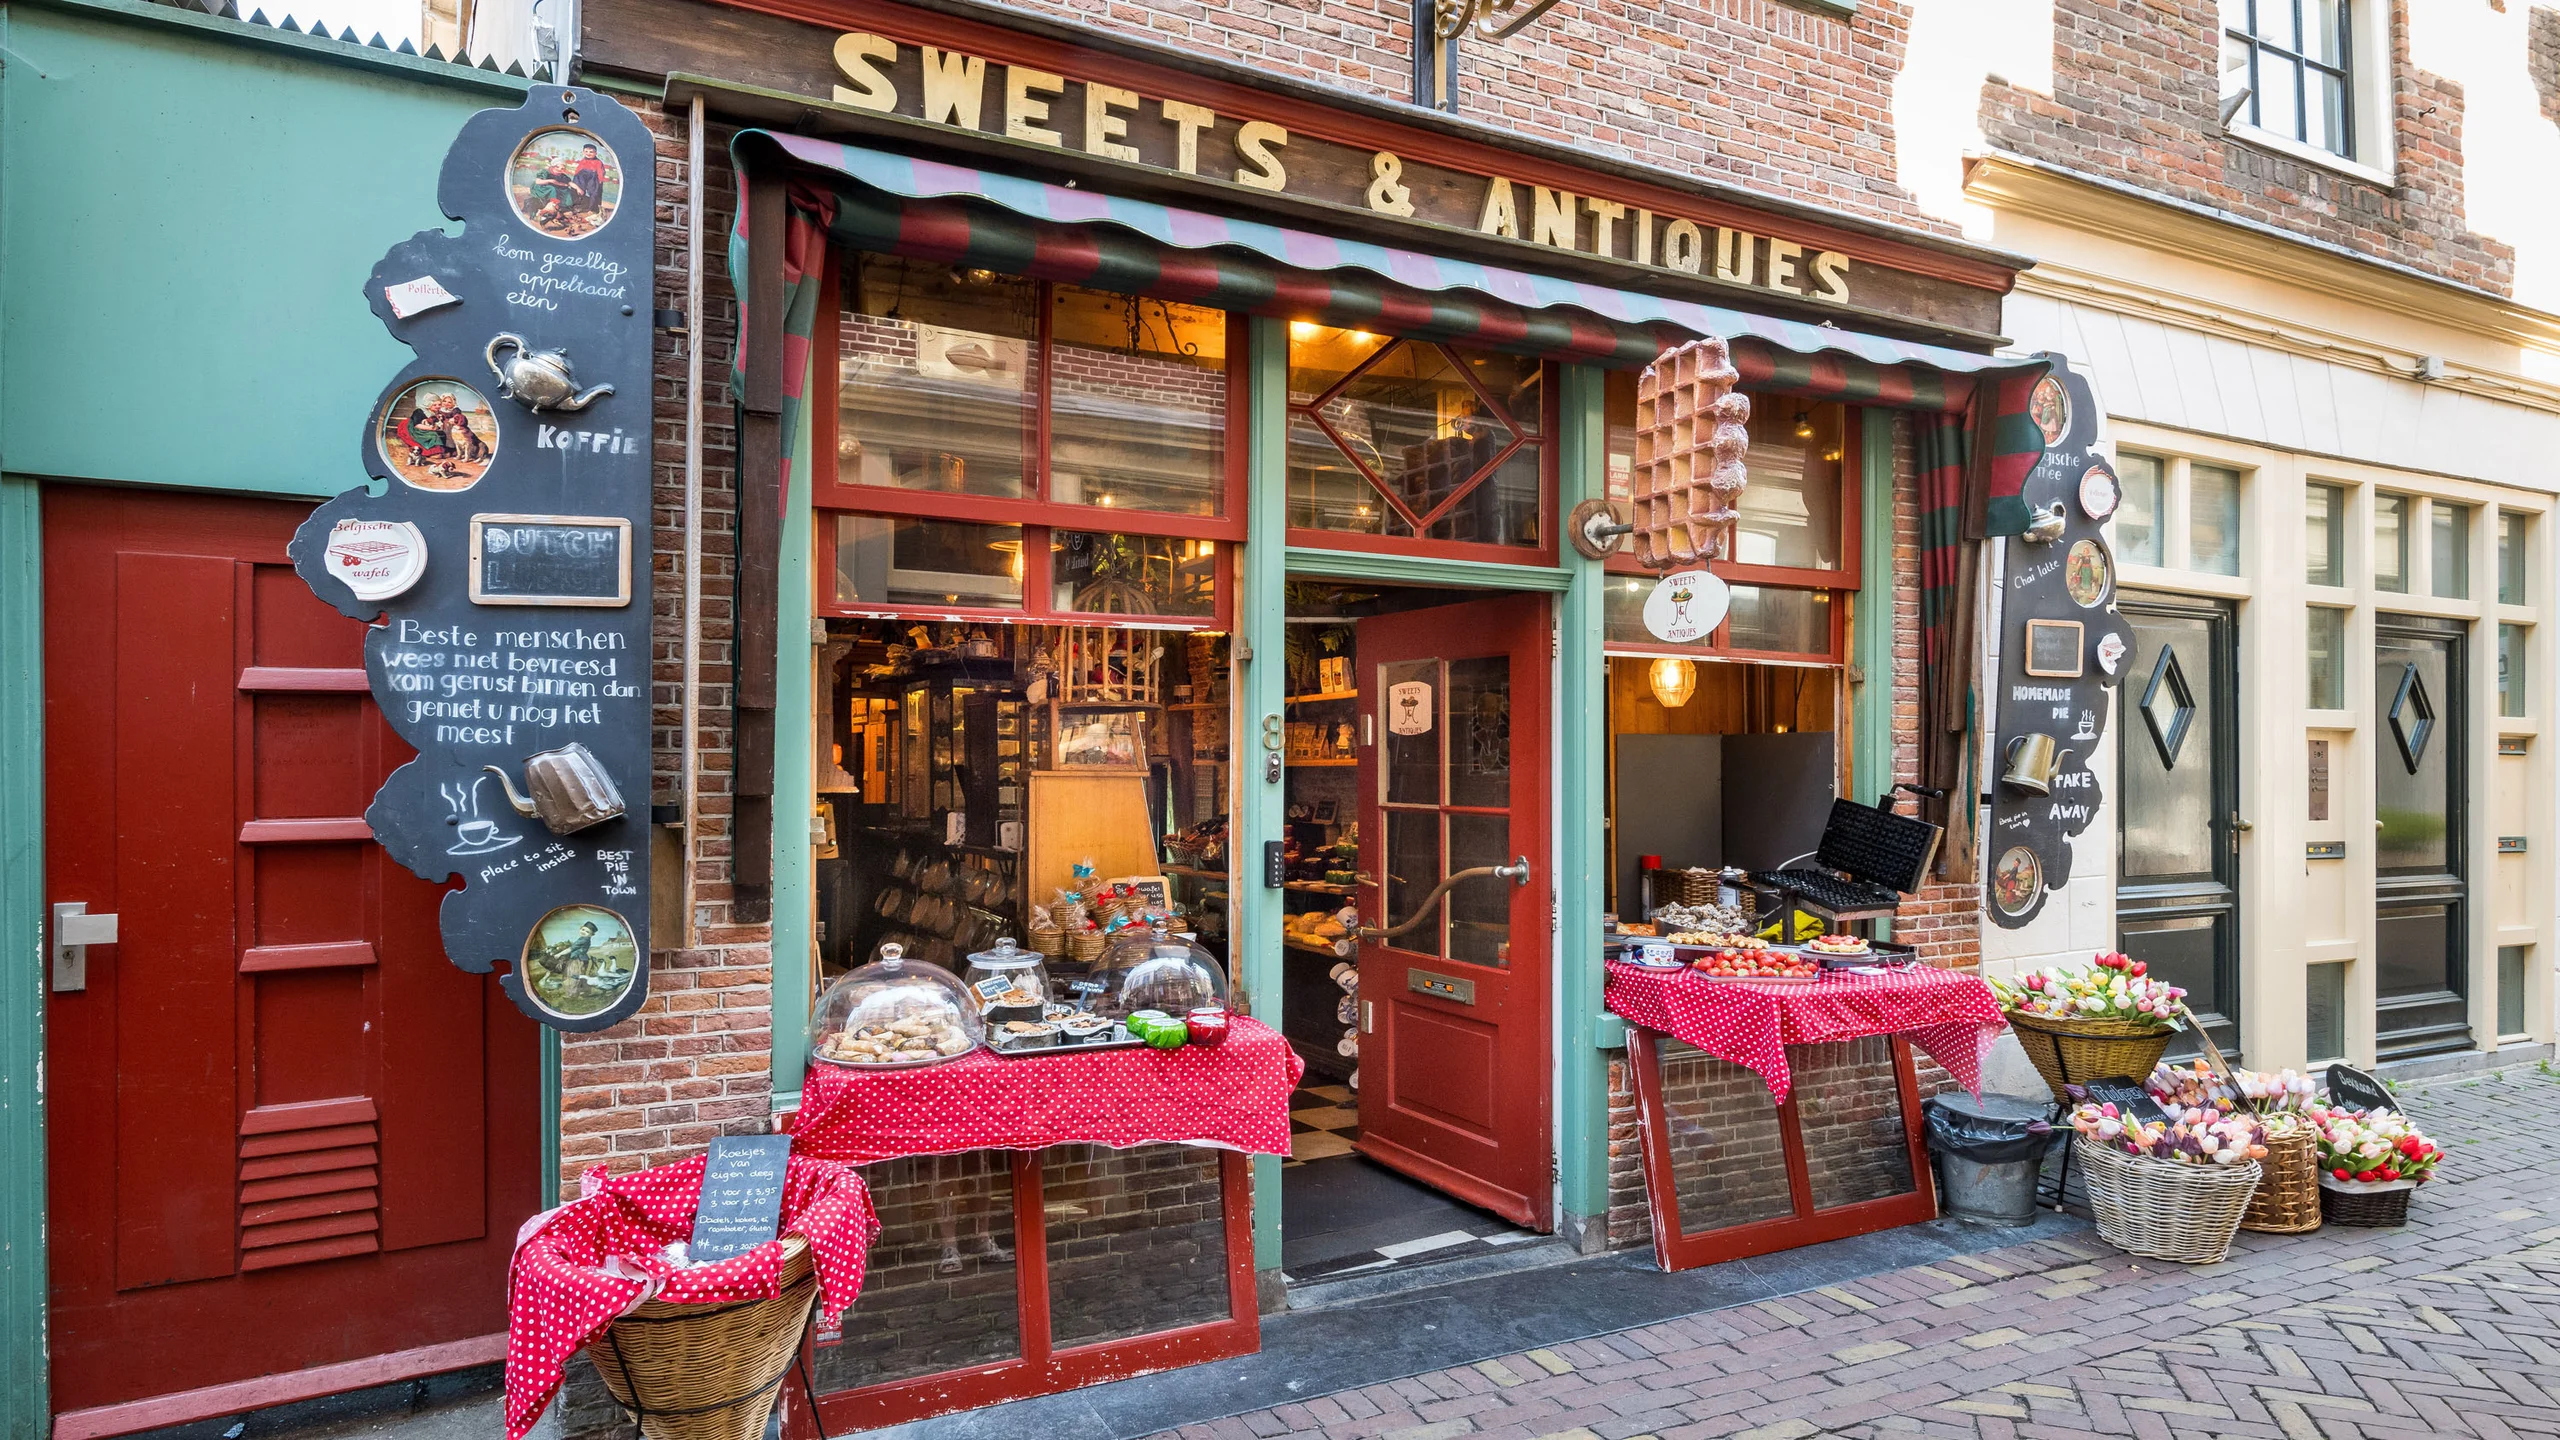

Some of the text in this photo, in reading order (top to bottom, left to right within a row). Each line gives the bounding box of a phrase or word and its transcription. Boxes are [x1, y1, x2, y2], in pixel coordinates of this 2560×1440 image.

[833, 32, 1850, 304] SWEETS & ANTIQUES
[492, 234, 628, 281] kom gezellig
[506, 291, 558, 311] eten
[1610, 471, 1629, 480] LARM
[334, 521, 393, 536] Belgische
[485, 528, 613, 558] DUTCH
[352, 567, 391, 580] wafels
[1669, 575, 1696, 587] SWEETS
[2013, 558, 2060, 590] Chai latte
[400, 619, 627, 650] Beste menschen
[1667, 628, 1697, 639] ANTIQUES
[381, 652, 617, 677] wees niet bevreesd
[388, 673, 642, 698] kom gerust binnen dan
[1399, 687, 1421, 695] SWEETS
[2012, 685, 2071, 702] HOMEMADE
[406, 699, 602, 728] geniet u nog het
[2052, 707, 2069, 720] PIE
[437, 725, 516, 745] meest
[1263, 713, 1286, 750] 8
[2054, 772, 2092, 788] TAKE
[2049, 803, 2090, 823] AWAY
[524, 850, 540, 862] to
[544, 842, 565, 855] sit
[535, 849, 576, 872] inside
[597, 849, 634, 862] BEST
[2089, 1084, 2148, 1107] Tulpen
[730, 1160, 750, 1168] van
[711, 1170, 774, 1182] eigen deeg
[711, 1189, 717, 1197] 1
